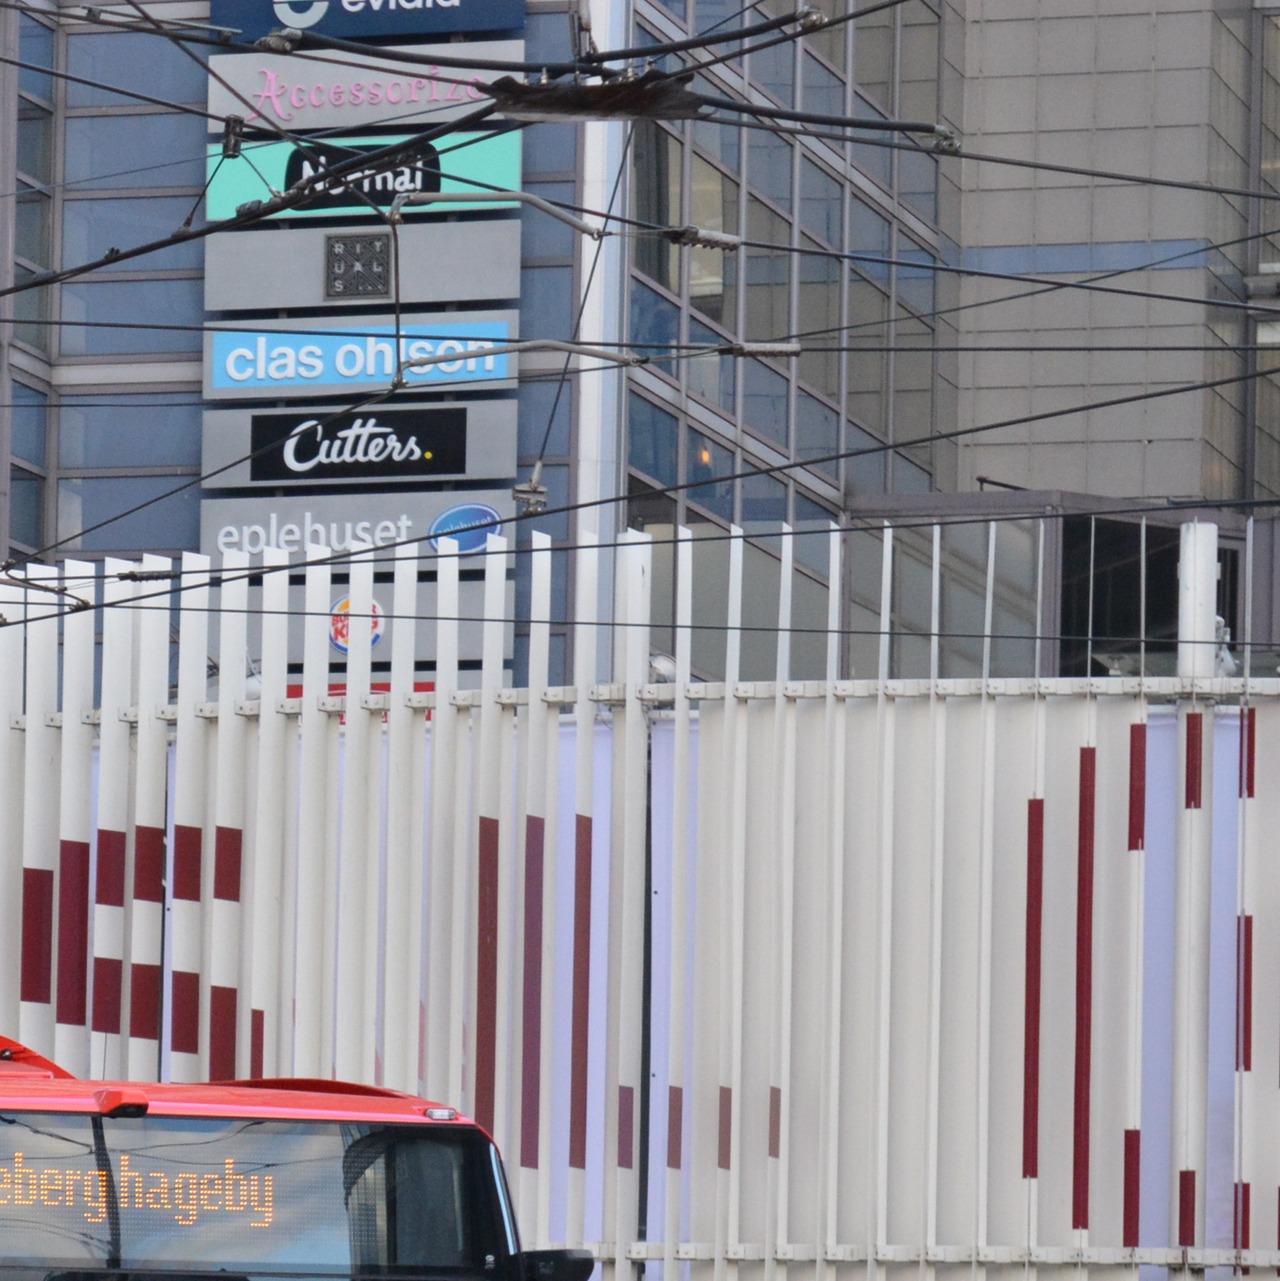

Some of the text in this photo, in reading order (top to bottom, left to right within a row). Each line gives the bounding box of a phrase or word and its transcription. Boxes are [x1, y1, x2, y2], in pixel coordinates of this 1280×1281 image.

[247, 65, 486, 121] Accessorize
[225, 332, 494, 382] clas ohlson
[217, 512, 413, 555] eplehuset
[120, 1154, 274, 1228] hageby
